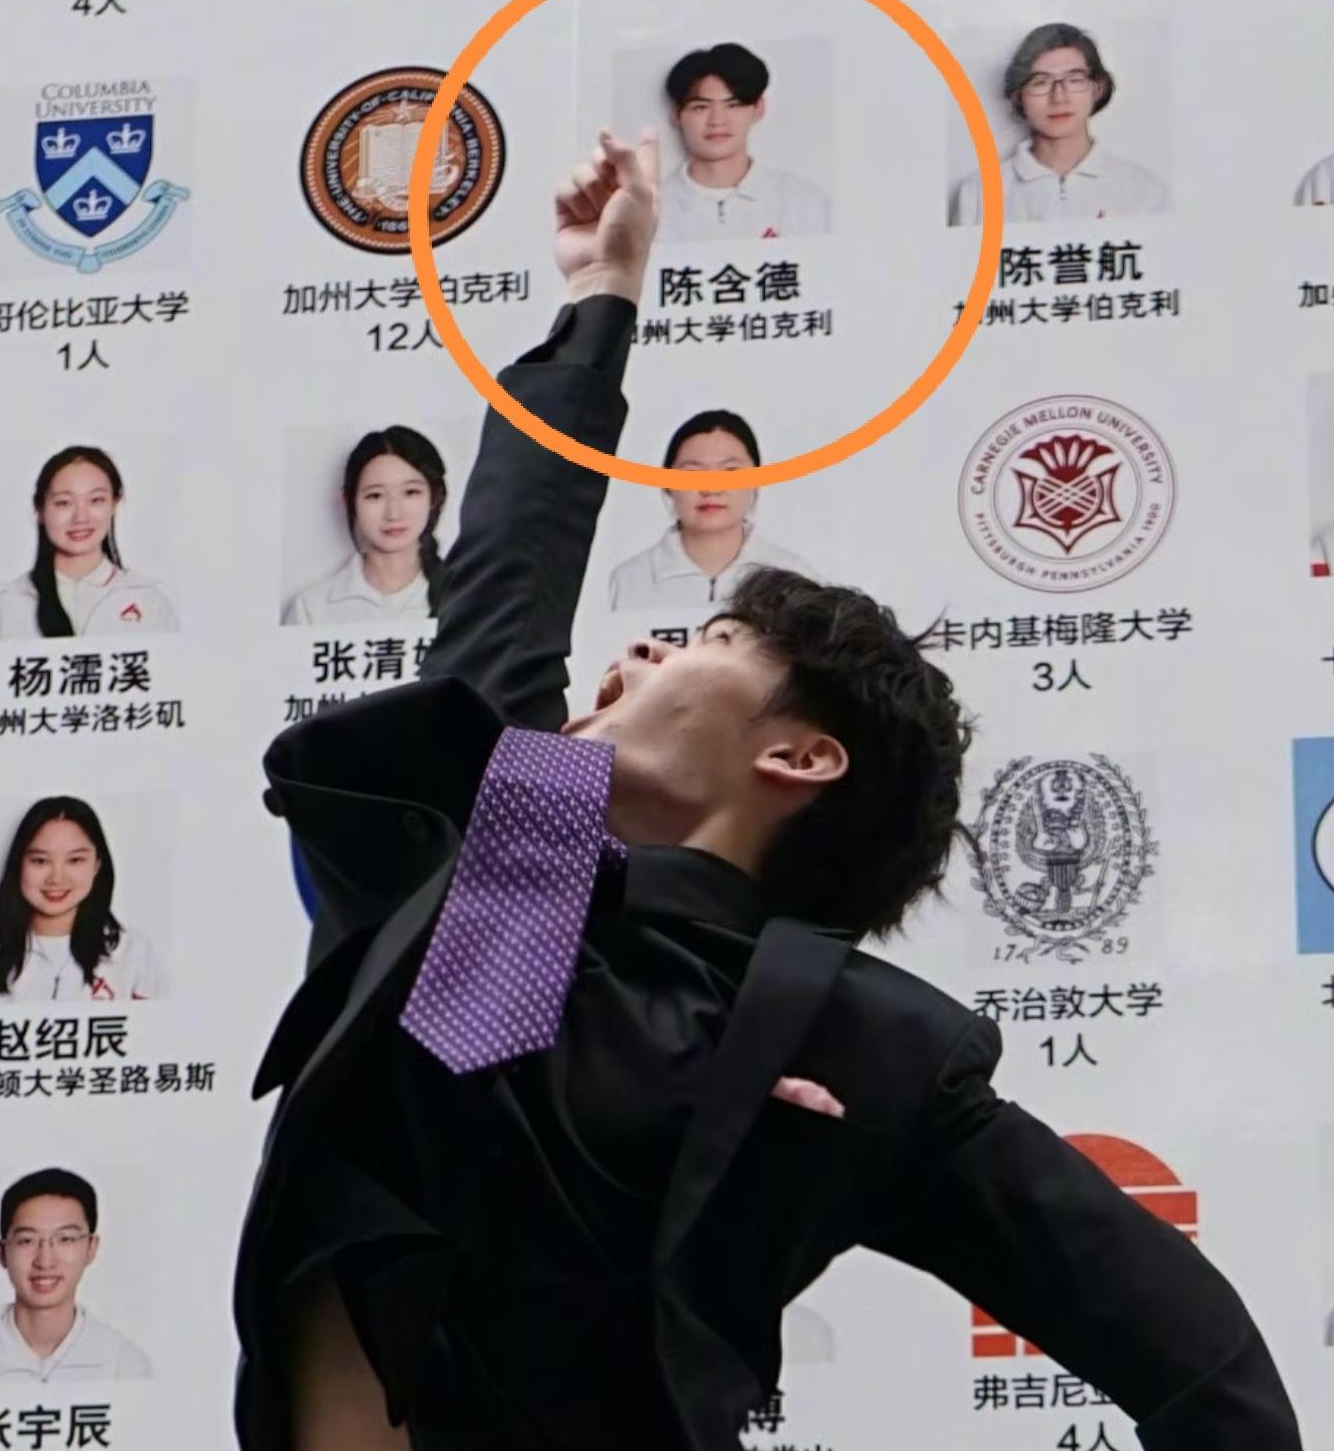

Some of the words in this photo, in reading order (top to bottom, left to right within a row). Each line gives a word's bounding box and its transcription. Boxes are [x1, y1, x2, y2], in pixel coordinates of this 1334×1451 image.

[34, 96, 157, 119] UNIVERSITY
[40, 79, 152, 101] COLUMBIA
[998, 239, 1144, 289] 陈誉航
[658, 260, 801, 308] 陈含德
[367, 319, 444, 352] 12人
[57, 339, 110, 371] 1人
[971, 423, 1023, 495] CARNEGIE
[1023, 405, 1093, 428] MELLON
[1096, 411, 1164, 486] UNIVERSITY
[931, 607, 1193, 651] 卡内基梅隆大学
[1032, 658, 1092, 692] 3人
[972, 982, 1164, 1022] 乔治敦大学
[1039, 1032, 1098, 1068] 1人
